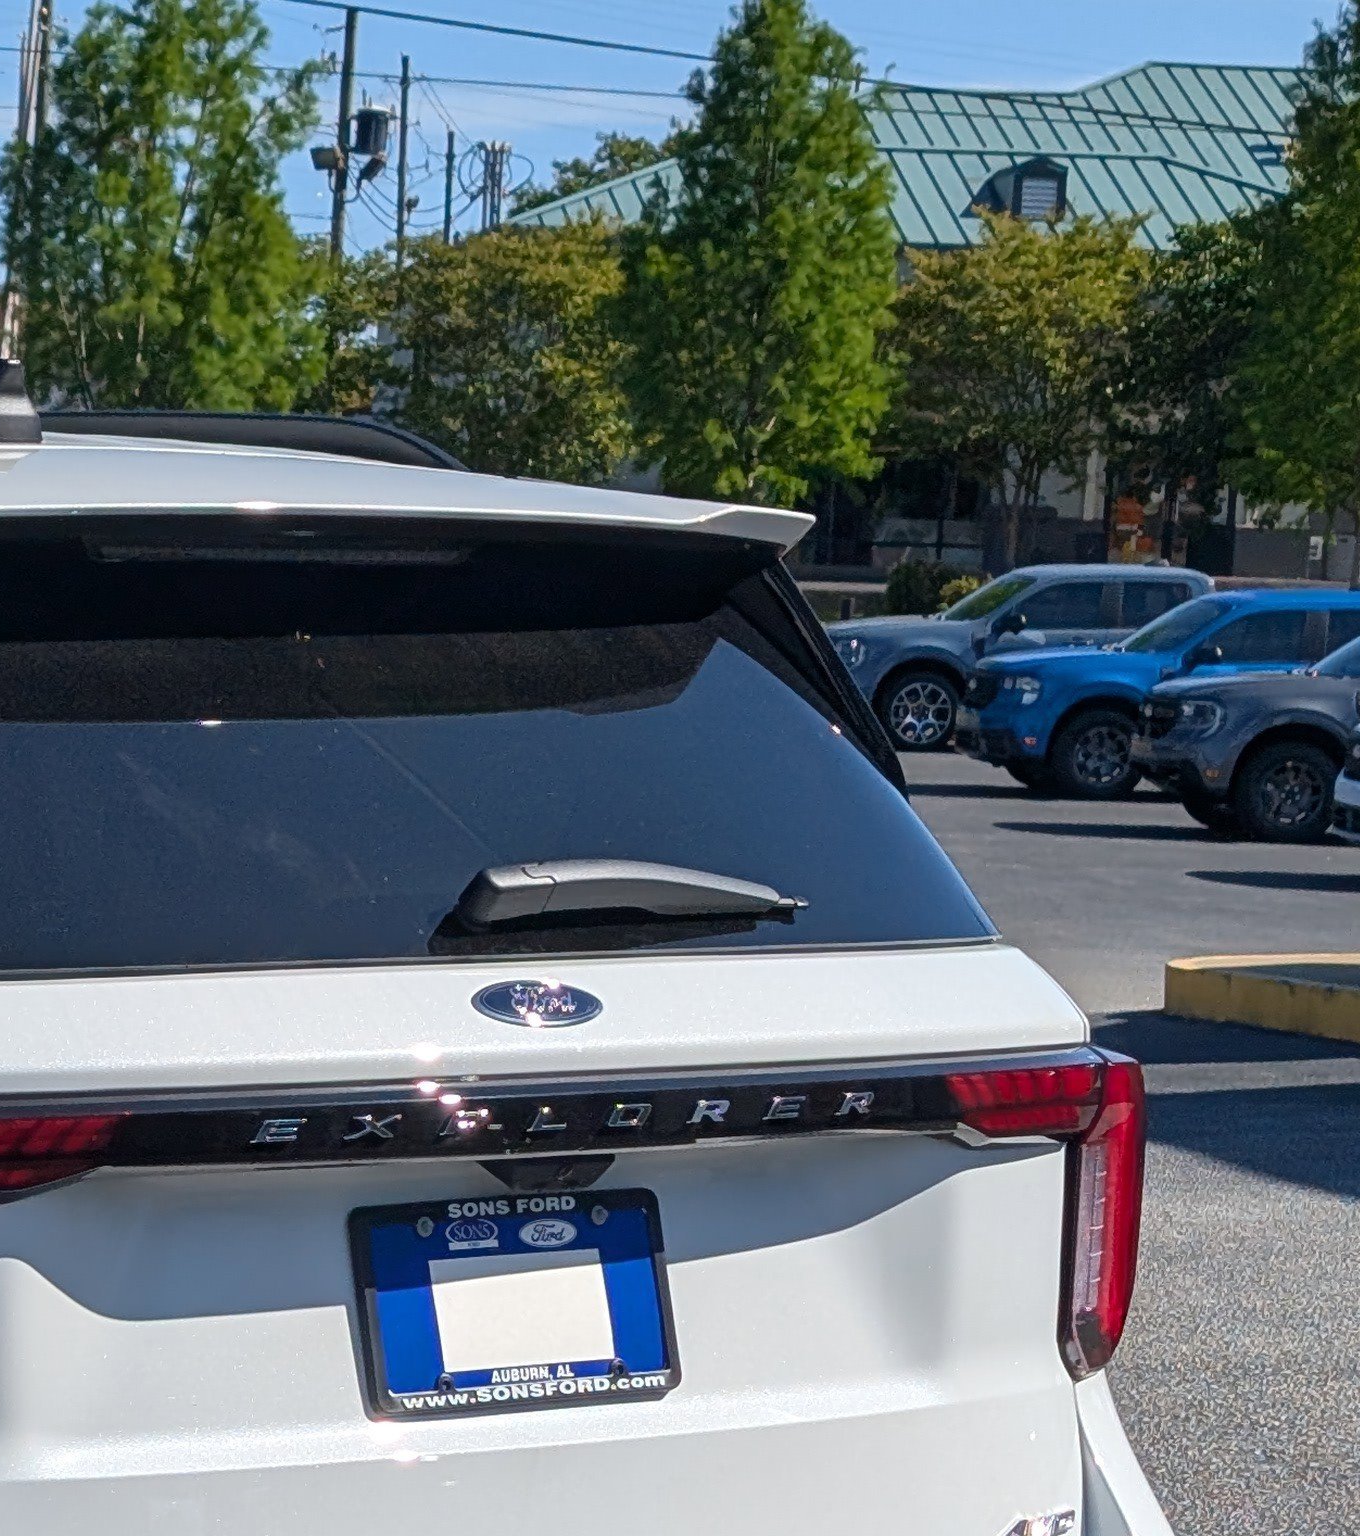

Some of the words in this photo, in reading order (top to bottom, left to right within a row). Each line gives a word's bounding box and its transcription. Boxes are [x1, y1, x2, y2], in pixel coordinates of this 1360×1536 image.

[248, 1090, 876, 1146] EXPLORER
[446, 1199, 511, 1219] SONS
[515, 1195, 577, 1214] FORD
[452, 1223, 492, 1241] SONS
[530, 1223, 567, 1243] Ford
[490, 1365, 554, 1384] AUBURN,
[556, 1363, 576, 1378] AL
[402, 1374, 666, 1410] www.SONSFORD.com
